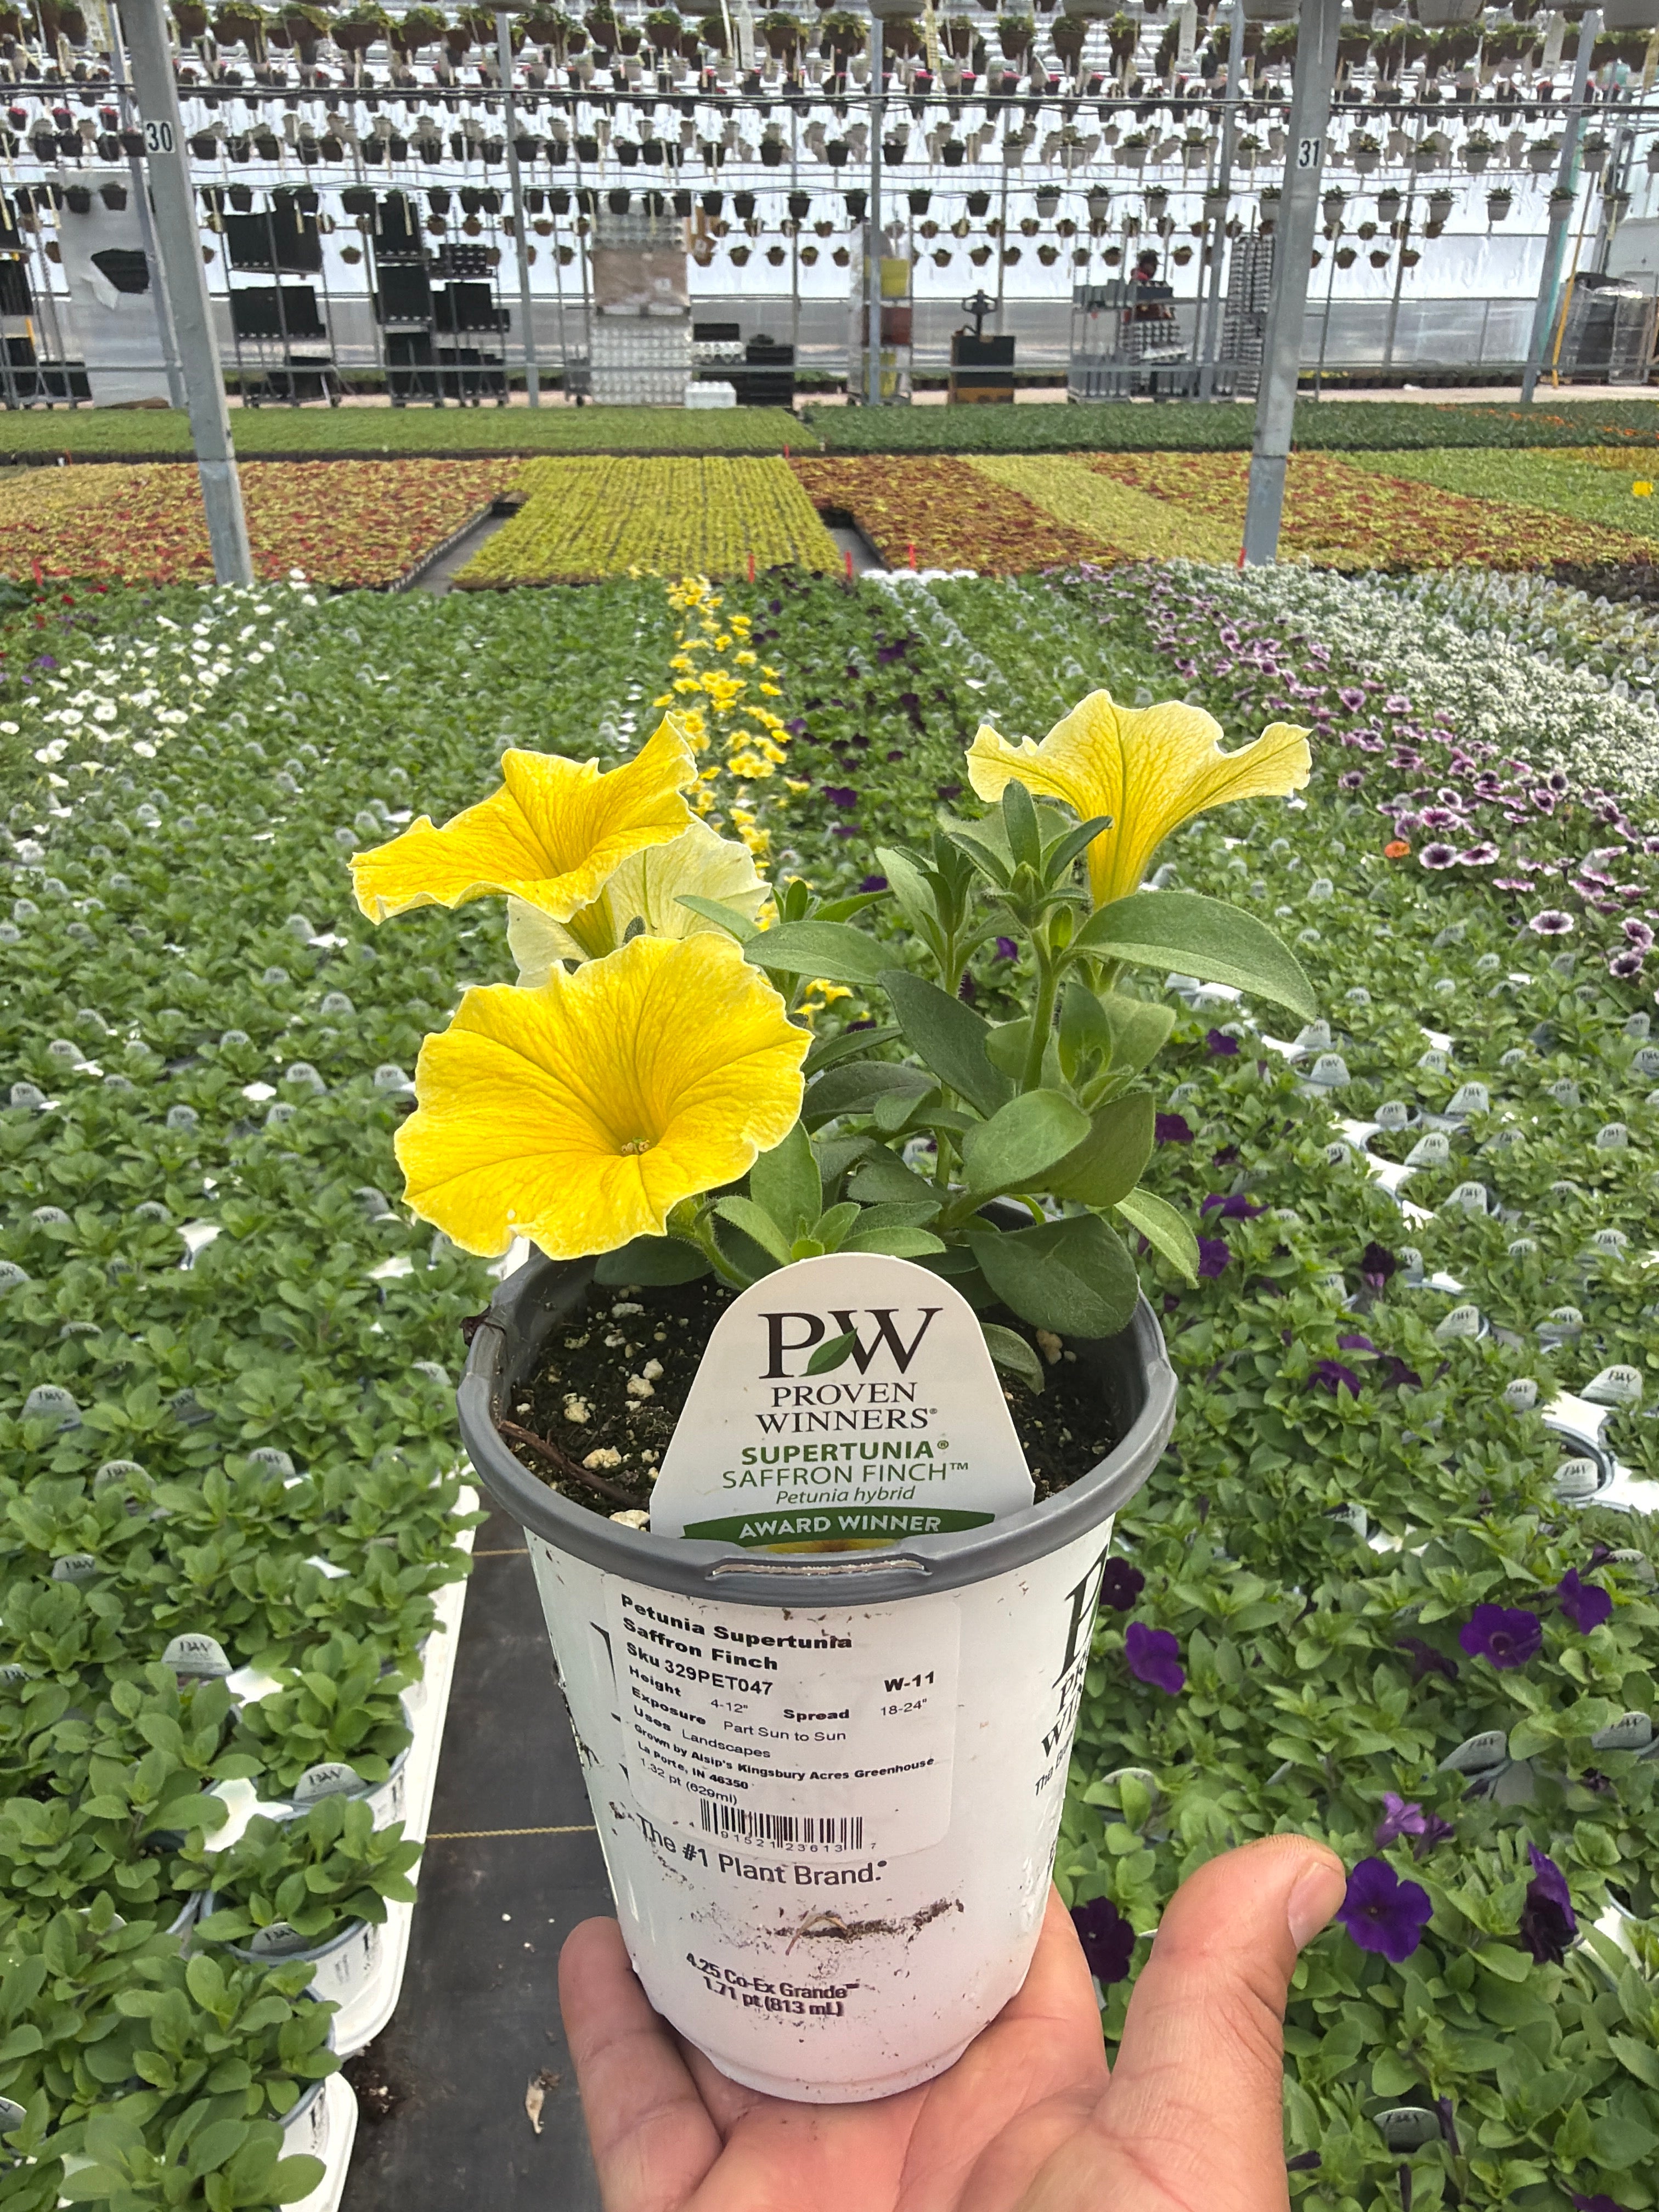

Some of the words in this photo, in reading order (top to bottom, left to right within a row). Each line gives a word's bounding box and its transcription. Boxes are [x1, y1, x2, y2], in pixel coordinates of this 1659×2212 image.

[146, 122, 173, 151] 30
[1299, 140, 1319, 167] 31
[758, 1307, 944, 1379] PW
[771, 1382, 917, 1408] PROVEN
[722, 1464, 853, 1488] SAFFRON
[775, 1488, 849, 1505] Petunia
[854, 1485, 916, 1505] hybrid
[738, 1516, 831, 1539] AWARD
[838, 1514, 941, 1532] WINNER
[620, 1593, 705, 1635] Petunia
[713, 1626, 852, 1649] Supertunia
[623, 1617, 702, 1657] Saffron
[712, 1647, 778, 1671] Finch
[627, 1641, 660, 1668] Sku
[664, 1659, 773, 1696] 329PET047
[884, 1671, 934, 1692] W-11
[629, 1664, 681, 1697] Height
[710, 1699, 748, 1714] 4-12"
[631, 1686, 706, 1725] Exposure
[723, 1720, 754, 1735] Part
[758, 1726, 789, 1740] Sun
[795, 1732, 809, 1742] to
[814, 1731, 847, 1741] Sun
[783, 1708, 850, 1723] Spread
[880, 1698, 927, 1716] 18-24"
[634, 1705, 672, 1731] Uses
[682, 1729, 771, 1758] Landscapes
[634, 1724, 670, 1750] Grown
[673, 1743, 687, 1757] by
[691, 1751, 733, 1769] Alsip's
[738, 1763, 805, 1781] Kingsbury
[809, 1771, 849, 1780] Acres
[854, 1757, 935, 1778] Greenhouse
[638, 1741, 651, 1754] La
[653, 1750, 689, 1774] Porte,
[692, 1767, 706, 1779] IN
[709, 1774, 749, 1790] 46350
[669, 1774, 682, 1786] pt
[636, 1812, 676, 1853] The
[681, 1843, 709, 1867] #1
[718, 1853, 787, 1884] Plant
[724, 1968, 776, 1995] Co-Ex
